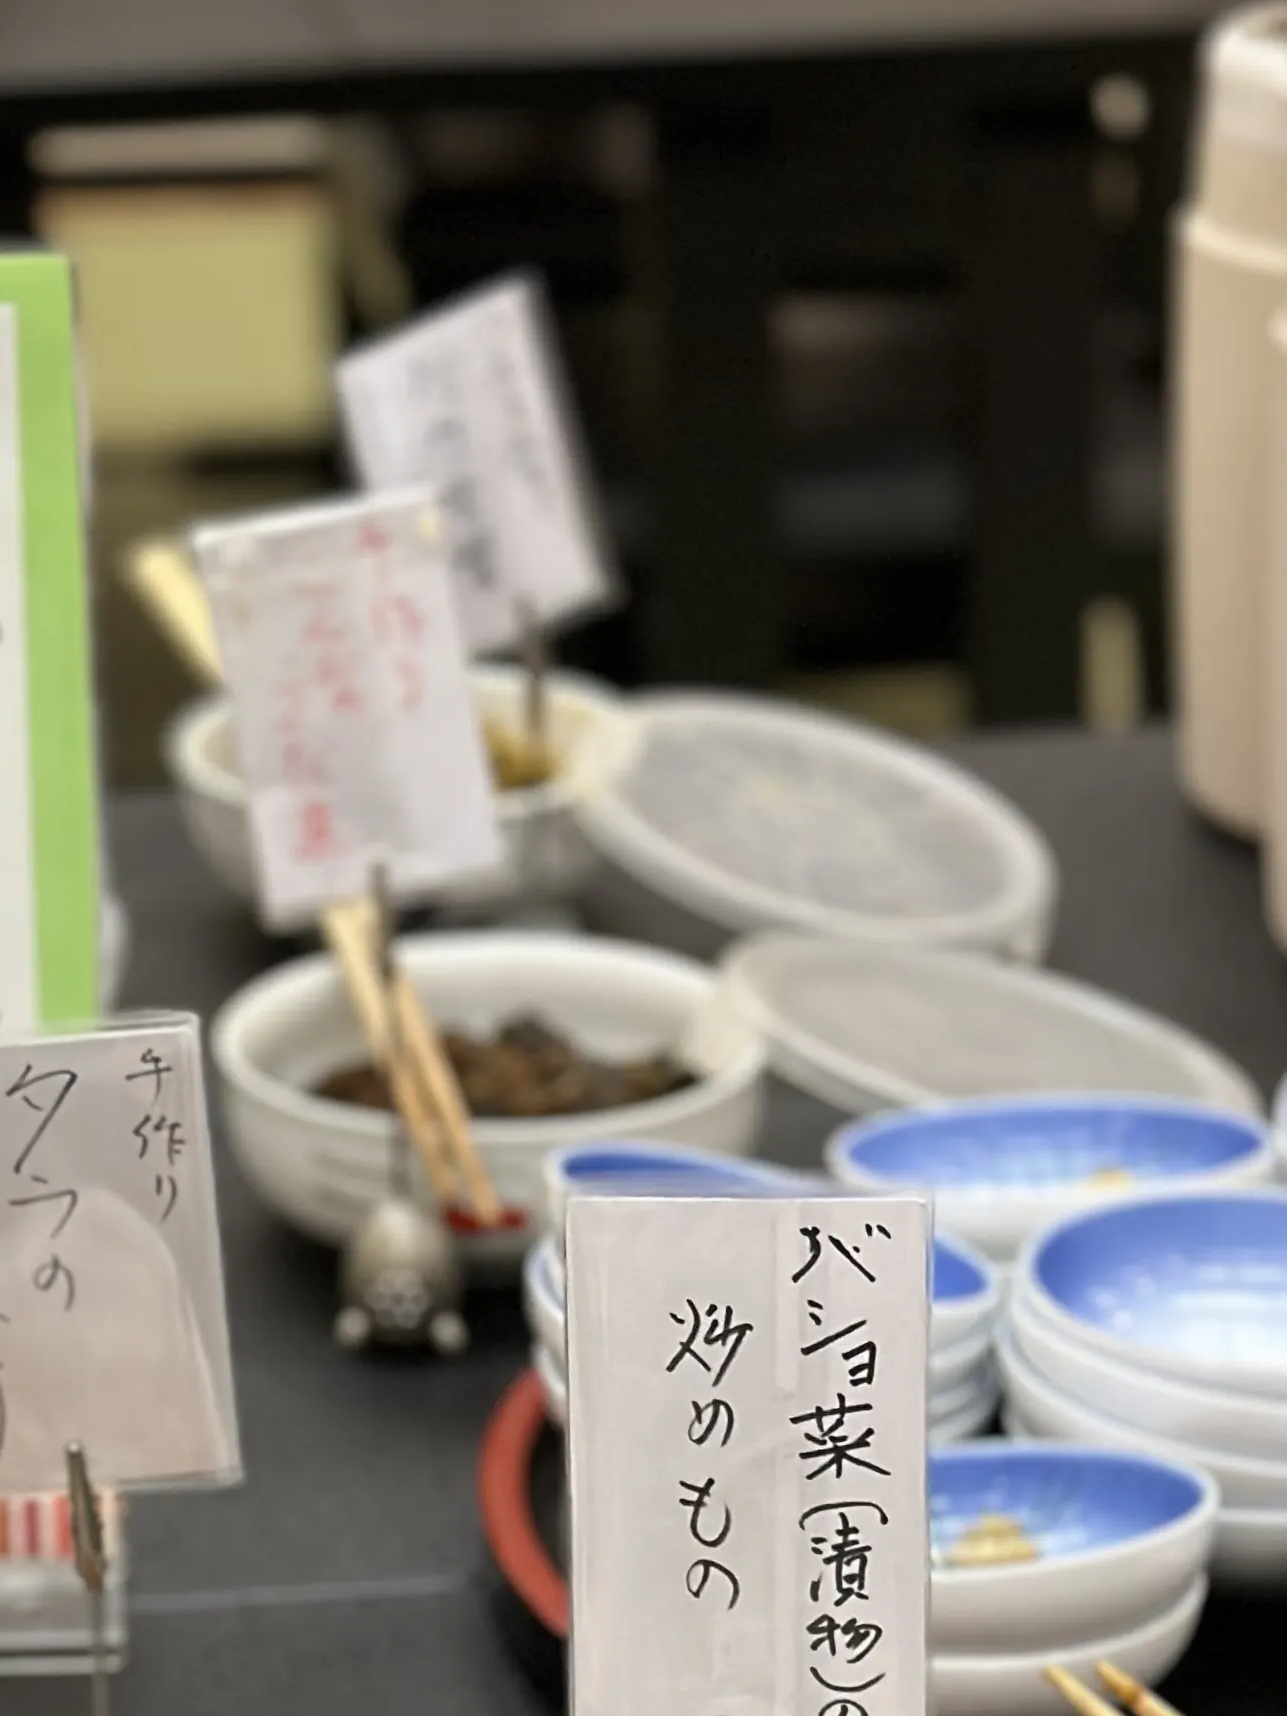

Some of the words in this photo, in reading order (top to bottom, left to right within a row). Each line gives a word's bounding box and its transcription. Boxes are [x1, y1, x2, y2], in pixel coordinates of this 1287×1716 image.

[125, 1048, 187, 1223] 手作り
[665, 1298, 754, 1610] 炒めもの
